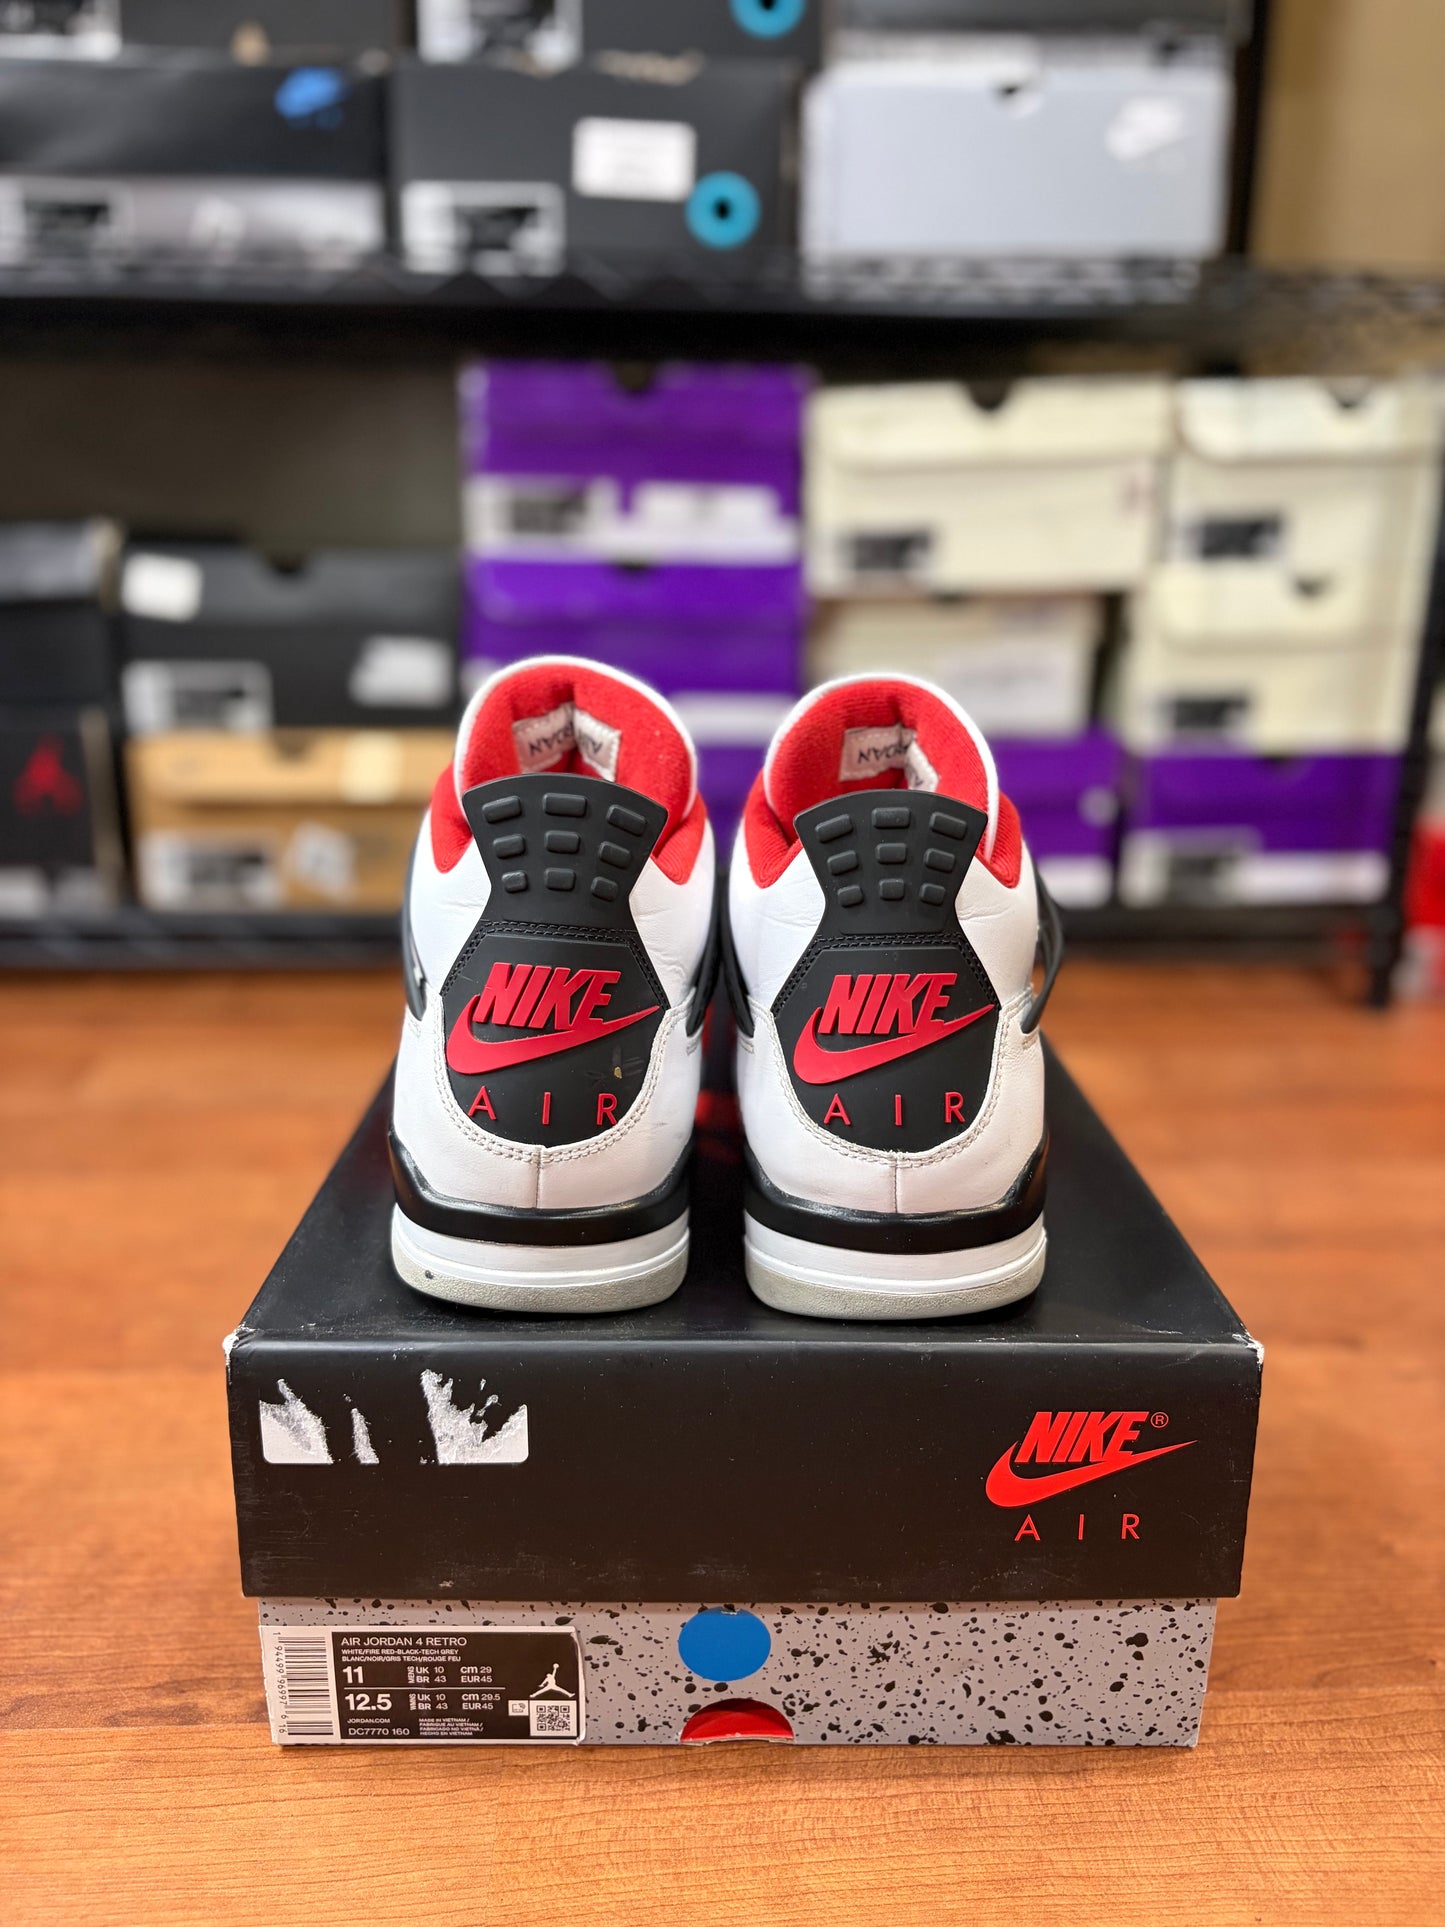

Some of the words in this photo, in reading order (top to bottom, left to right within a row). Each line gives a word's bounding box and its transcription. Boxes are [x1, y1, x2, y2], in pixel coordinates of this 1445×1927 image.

[472, 961, 622, 1031] NIKE
[817, 972, 958, 1035] NIKE
[467, 1085, 618, 1126] AIR
[823, 1091, 966, 1126] AIR
[1013, 1513, 1141, 1542] AIR
[341, 1636, 361, 1646] AIR
[363, 1636, 413, 1646] JORDAN
[415, 1637, 423, 1646] 4
[425, 1636, 468, 1646] RETRO
[342, 1665, 364, 1684] 11
[407, 1666, 415, 1684] MENS
[416, 1666, 429, 1674] UK
[434, 1666, 445, 1674] 10
[460, 1666, 478, 1674] cm
[480, 1666, 492, 1674] 29
[416, 1675, 430, 1683] BR
[434, 1675, 447, 1683] 43
[345, 1693, 392, 1711] 12.5
[417, 1693, 431, 1701] UK
[436, 1693, 446, 1701] 10
[461, 1693, 479, 1701] cm
[481, 1693, 501, 1701] 29.5
[418, 1702, 431, 1710] BR
[435, 1702, 448, 1710] 43
[348, 1727, 389, 1736] DC7770
[391, 1727, 410, 1736] 160
